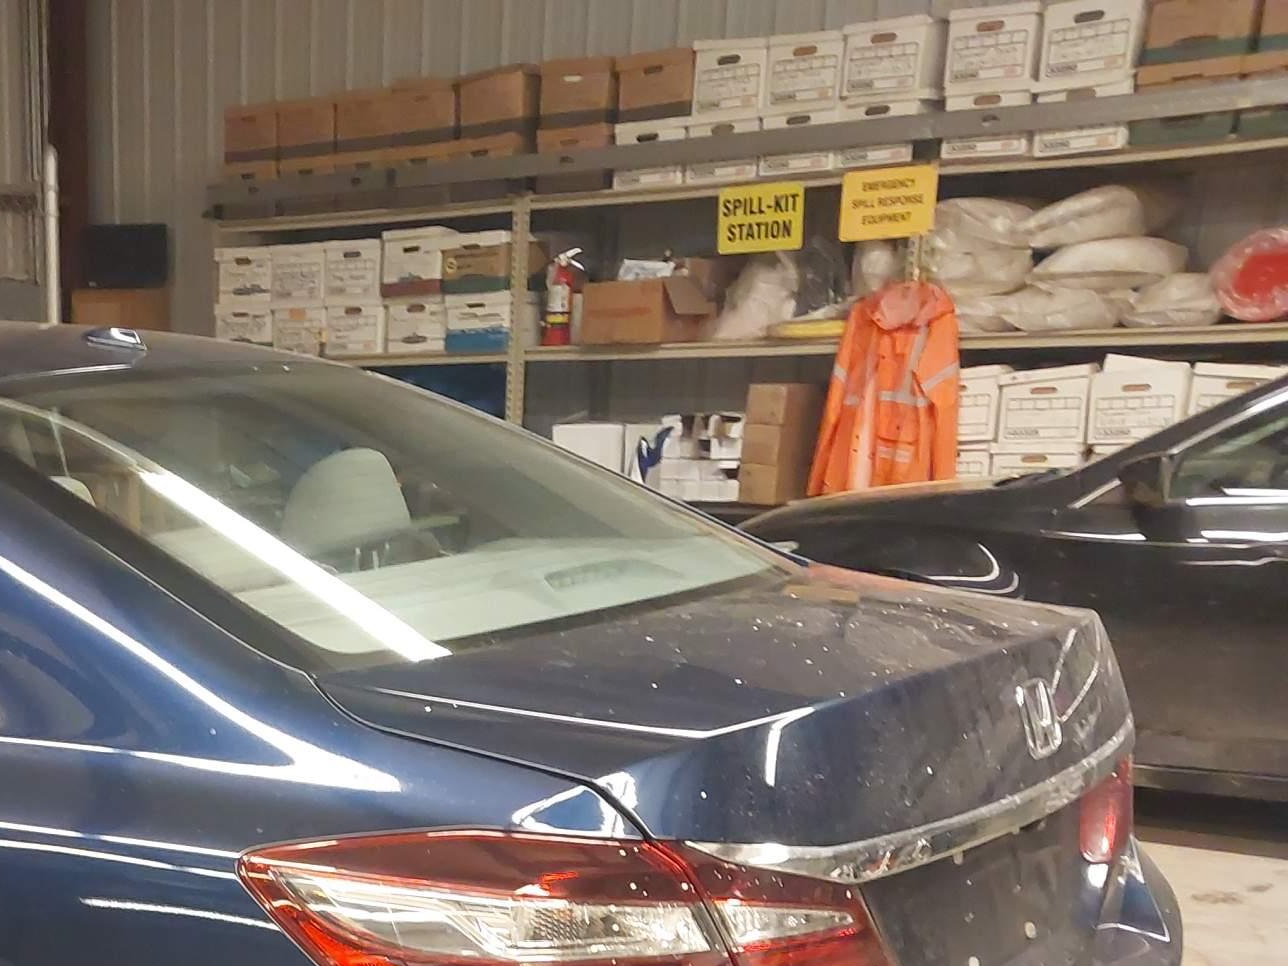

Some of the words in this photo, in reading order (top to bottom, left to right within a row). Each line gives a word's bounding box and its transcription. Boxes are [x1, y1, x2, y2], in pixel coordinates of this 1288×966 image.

[861, 178, 916, 192] EMERGENCY
[722, 193, 800, 218] SPILL-KIT
[850, 198, 875, 210] SPILL
[877, 193, 924, 209] RESPONSE
[861, 211, 913, 226] EQUIPMENT
[727, 219, 793, 242] STATION
